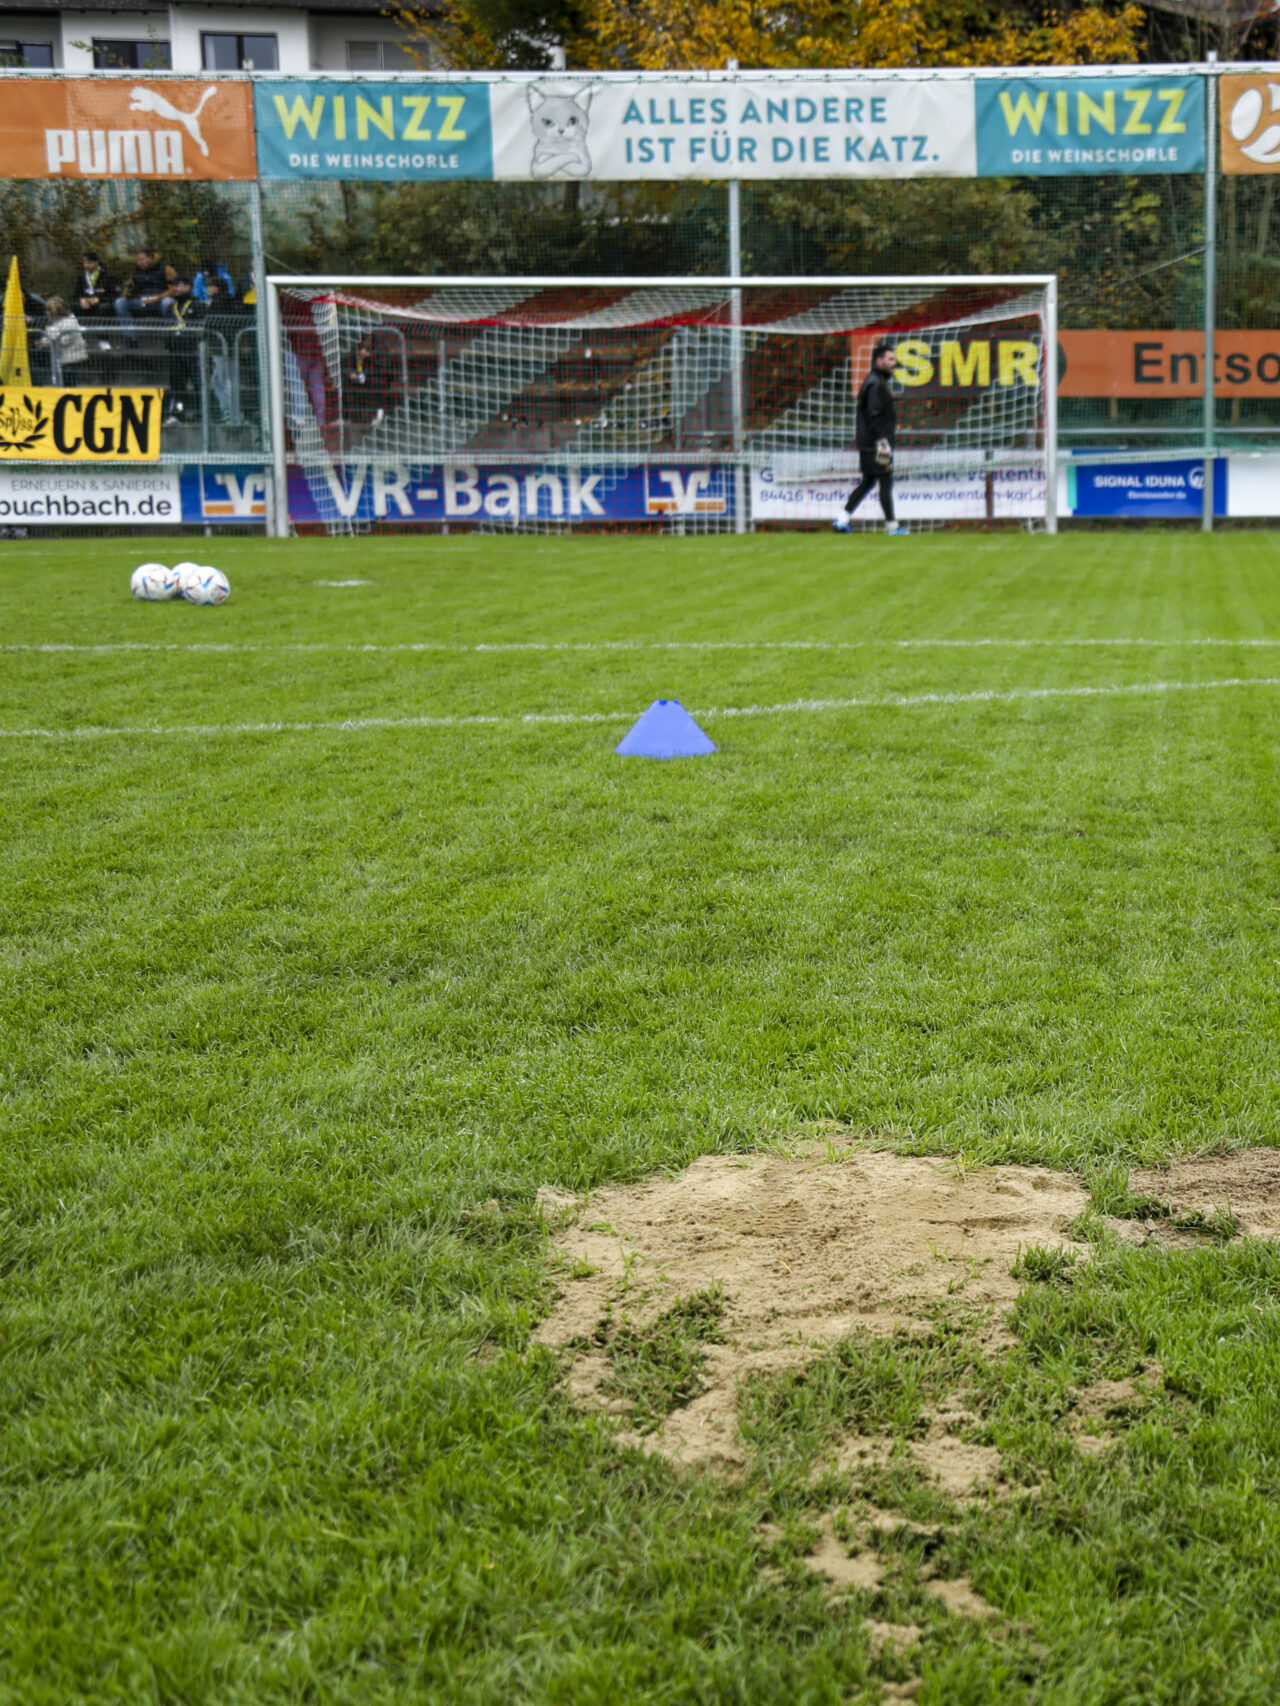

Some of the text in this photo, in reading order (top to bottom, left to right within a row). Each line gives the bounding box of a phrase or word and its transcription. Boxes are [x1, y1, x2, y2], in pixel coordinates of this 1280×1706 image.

[274, 95, 467, 141] WINZZ
[622, 97, 887, 125] ALLES ANDERE
[998, 89, 1186, 137] WINZZ
[45, 129, 185, 174] PUMA
[289, 153, 459, 169] DIE WEINSCHORLE
[625, 130, 939, 163] IST FÜR DIE KATZ.
[1012, 147, 1179, 164] DIE WEINSCHORLE
[894, 339, 1042, 387] SMR
[53, 394, 154, 454] CGN
[12, 479, 170, 491] ERNEUERN & SANIEREN
[326, 464, 604, 516] VR-Bank
[1094, 475, 1185, 488] SIGNAL IDUNA
